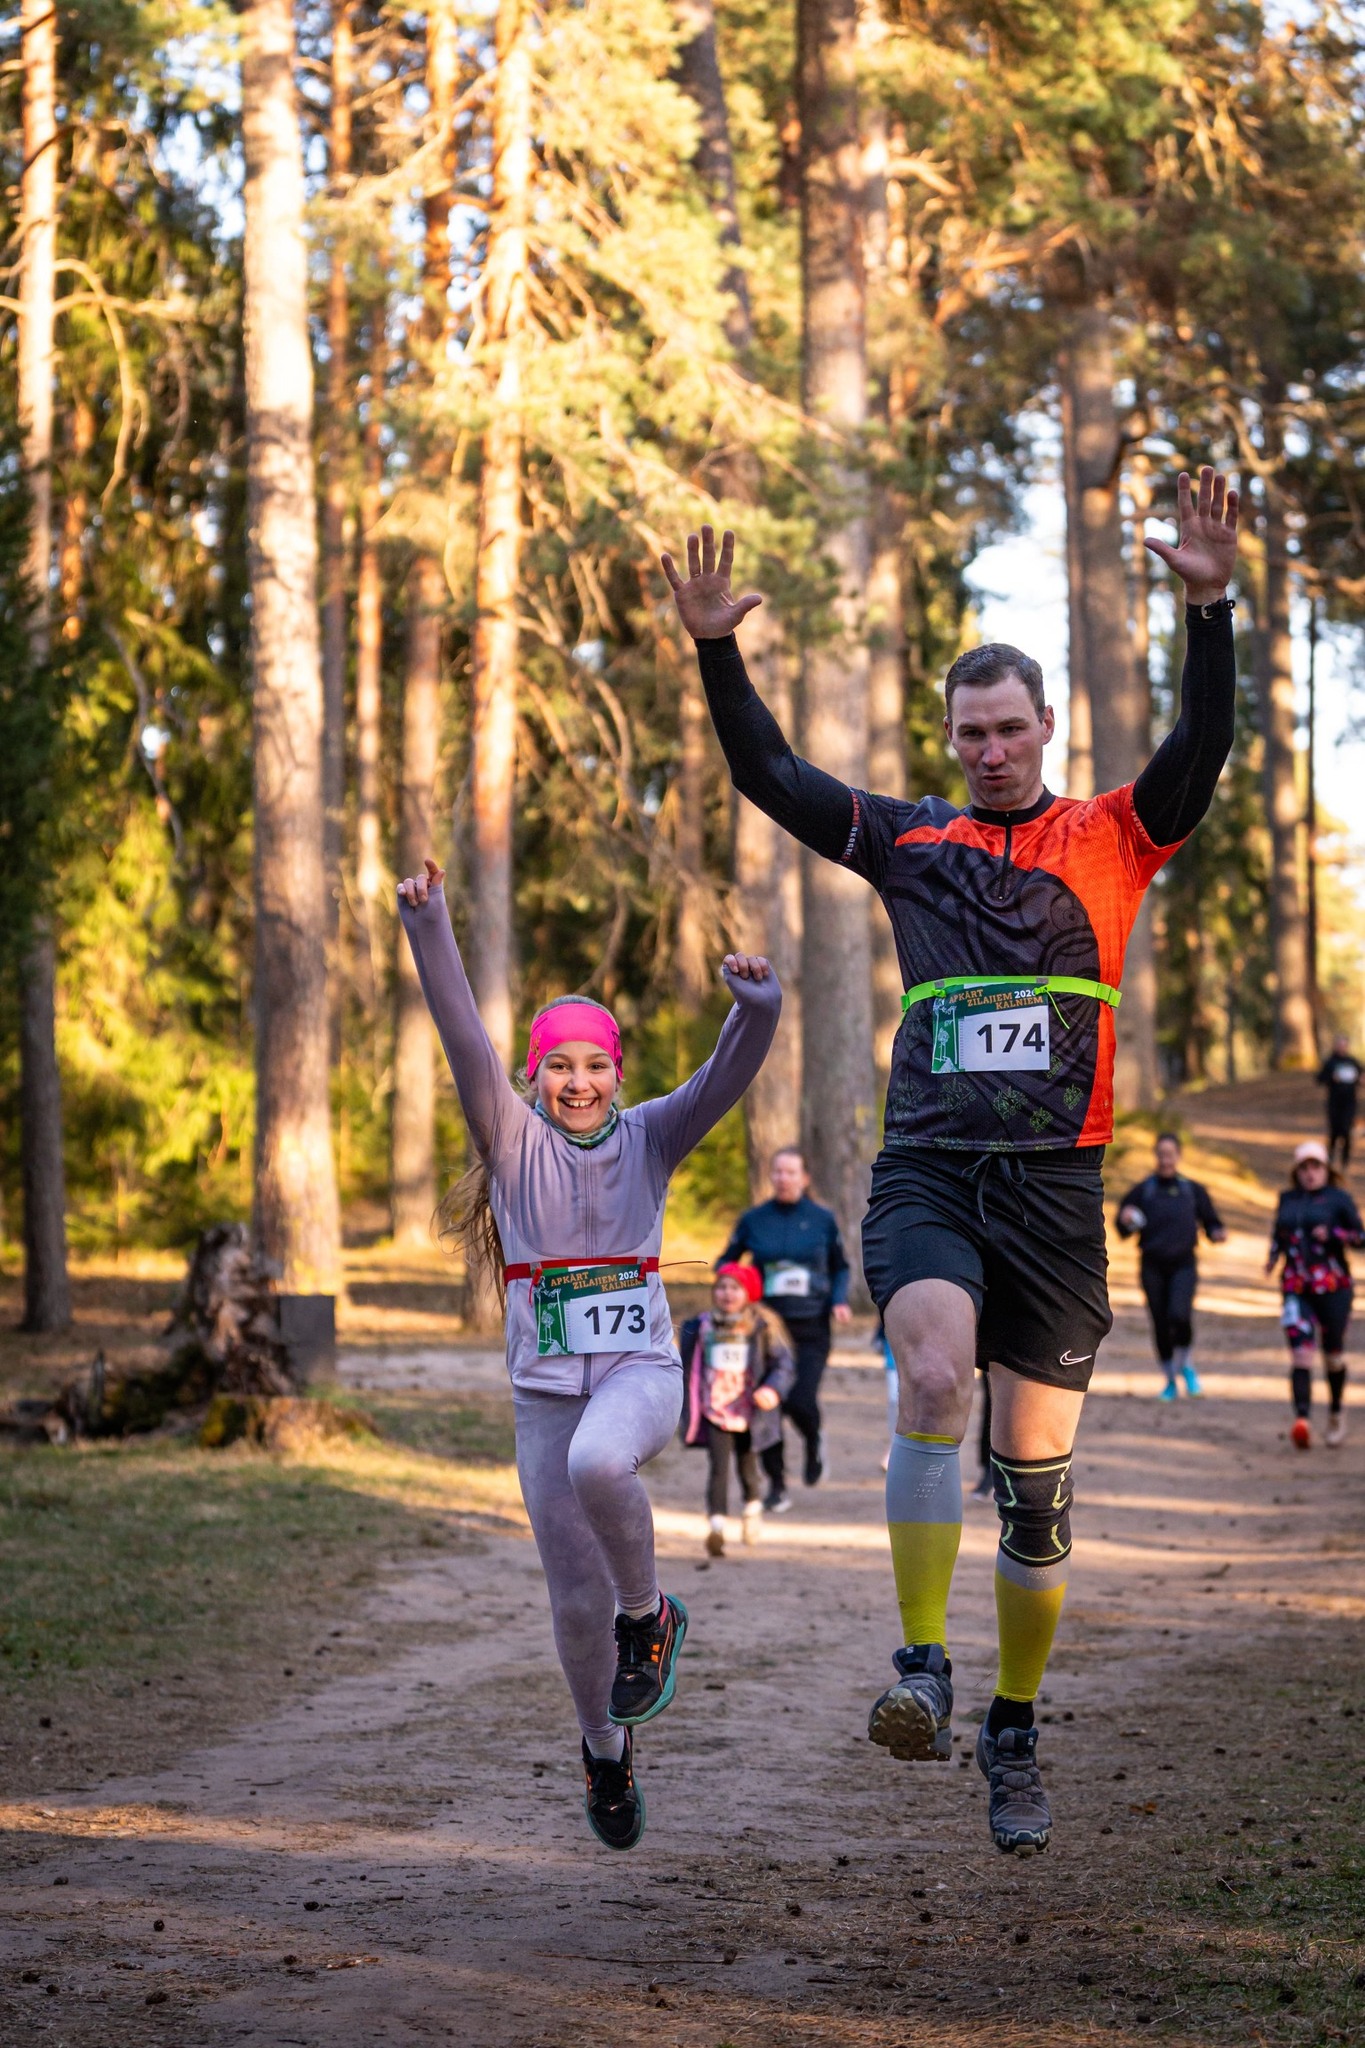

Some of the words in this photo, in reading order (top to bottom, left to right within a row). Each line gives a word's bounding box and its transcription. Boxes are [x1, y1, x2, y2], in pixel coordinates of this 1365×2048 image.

[967, 992, 1013, 1007] ZILAJIEM
[995, 996, 1043, 1010] KALNIEM
[976, 1022, 1046, 1054] 174
[572, 1274, 617, 1290] ZILAJIEM
[618, 1270, 639, 1281] 2026
[583, 1304, 646, 1336] 173
